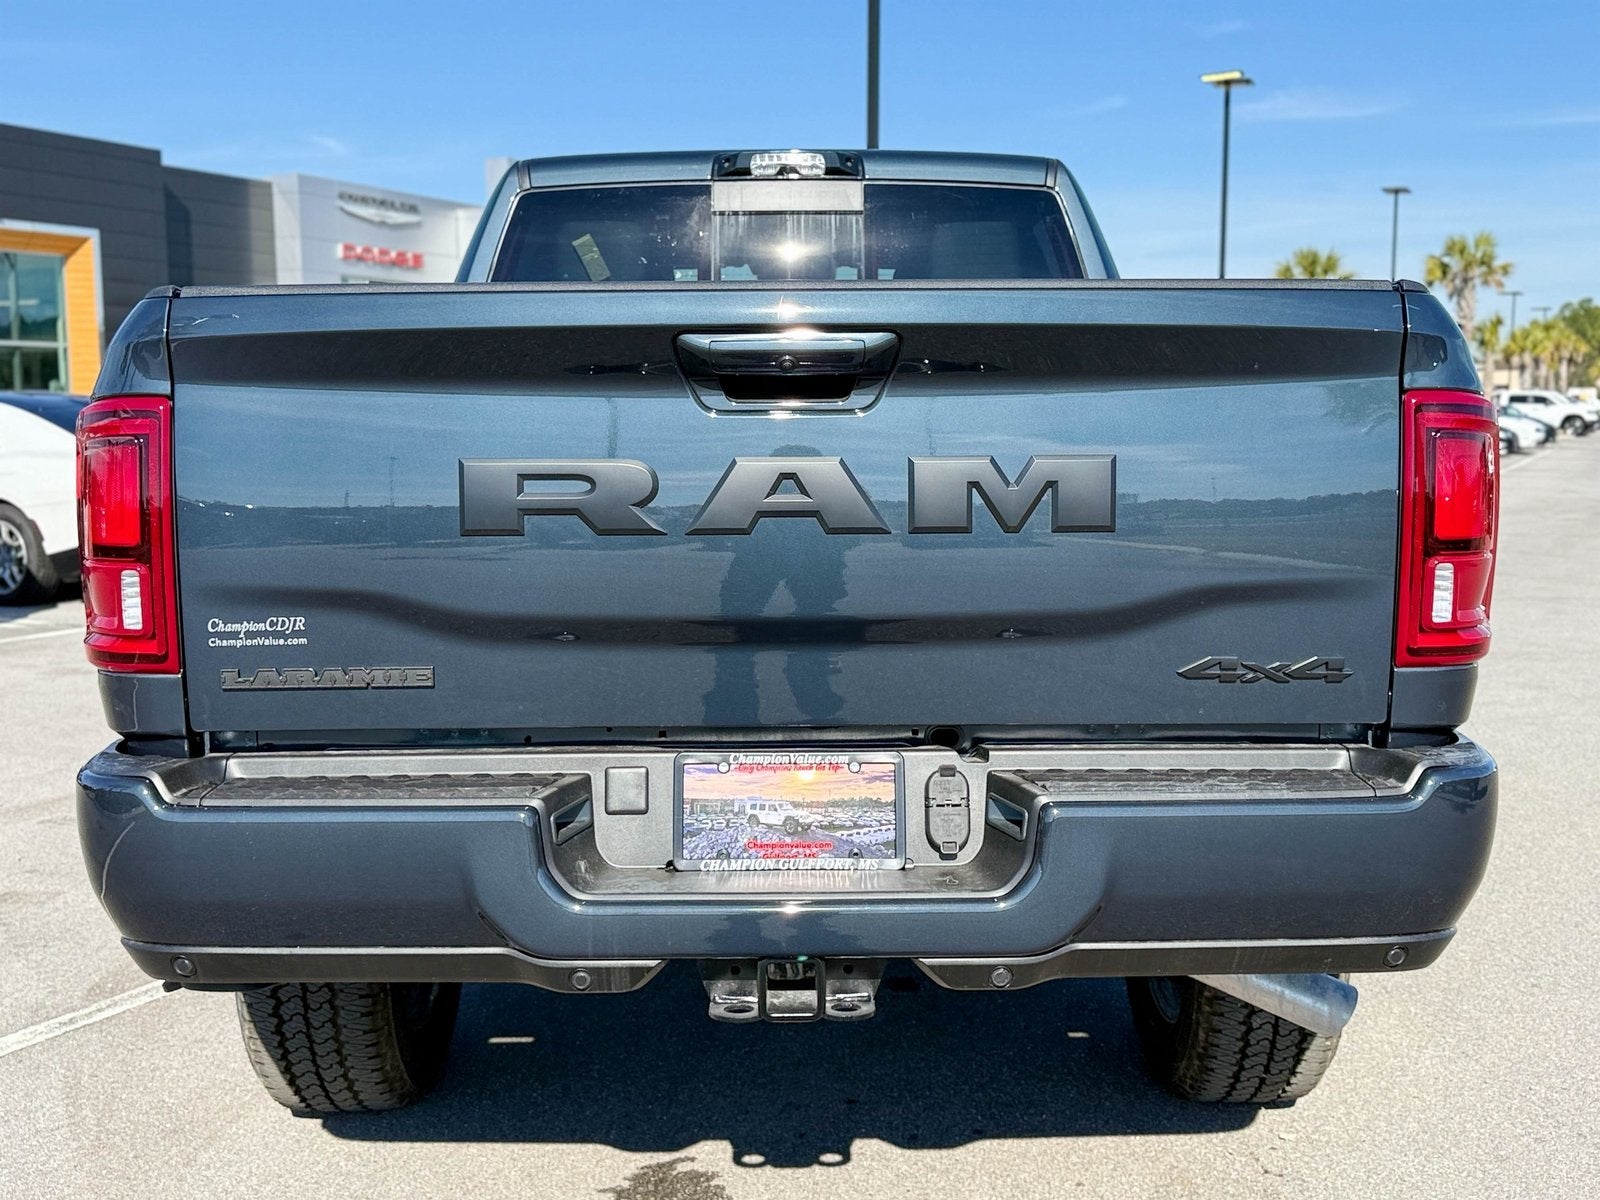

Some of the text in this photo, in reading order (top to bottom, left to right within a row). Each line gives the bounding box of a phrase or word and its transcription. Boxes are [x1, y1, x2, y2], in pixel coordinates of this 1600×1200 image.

[341, 242, 424, 269] DODGE
[459, 455, 1117, 536] RAM
[207, 616, 306, 638] ChampionCDJR
[207, 636, 308, 648] ChampionValue.com
[220, 665, 435, 691] LARAMIE
[1176, 655, 1354, 684] 4x4
[729, 752, 849, 766] ChampionValue.com
[746, 841, 832, 850] Championvalue.com
[699, 858, 774, 871] CHAMPION
[857, 858, 879, 871] MS
